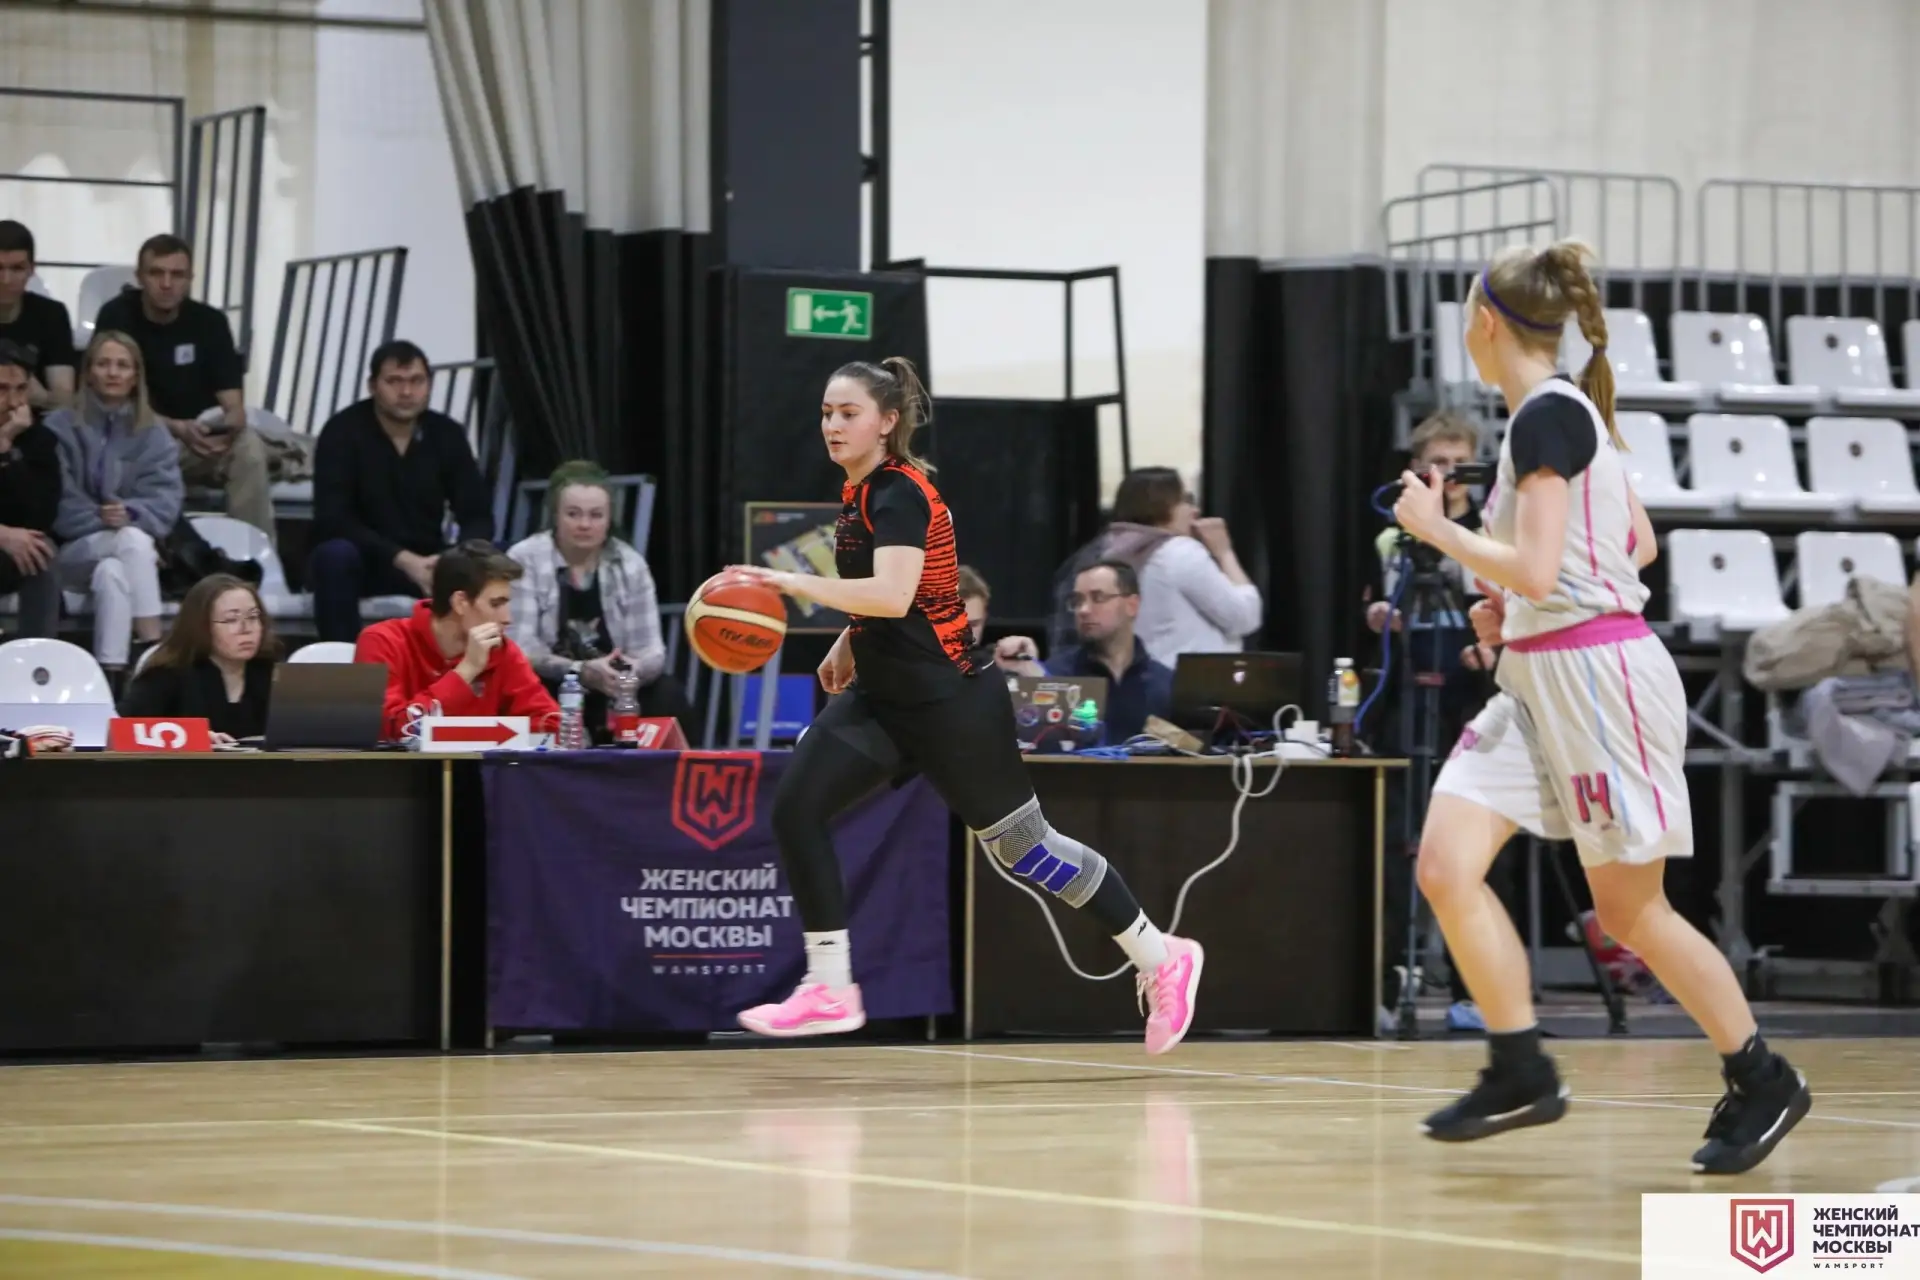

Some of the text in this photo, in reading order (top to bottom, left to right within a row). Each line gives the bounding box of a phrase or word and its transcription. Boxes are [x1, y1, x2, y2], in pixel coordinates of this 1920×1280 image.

[132, 721, 188, 749] 5
[1570, 771, 1614, 823] 14
[639, 863, 778, 892] ЖЕНСКИЙ
[620, 895, 794, 920] ЧЕМПИОНАТ
[644, 924, 773, 949] МОСКВЫ
[652, 963, 767, 976] WAMSPORT
